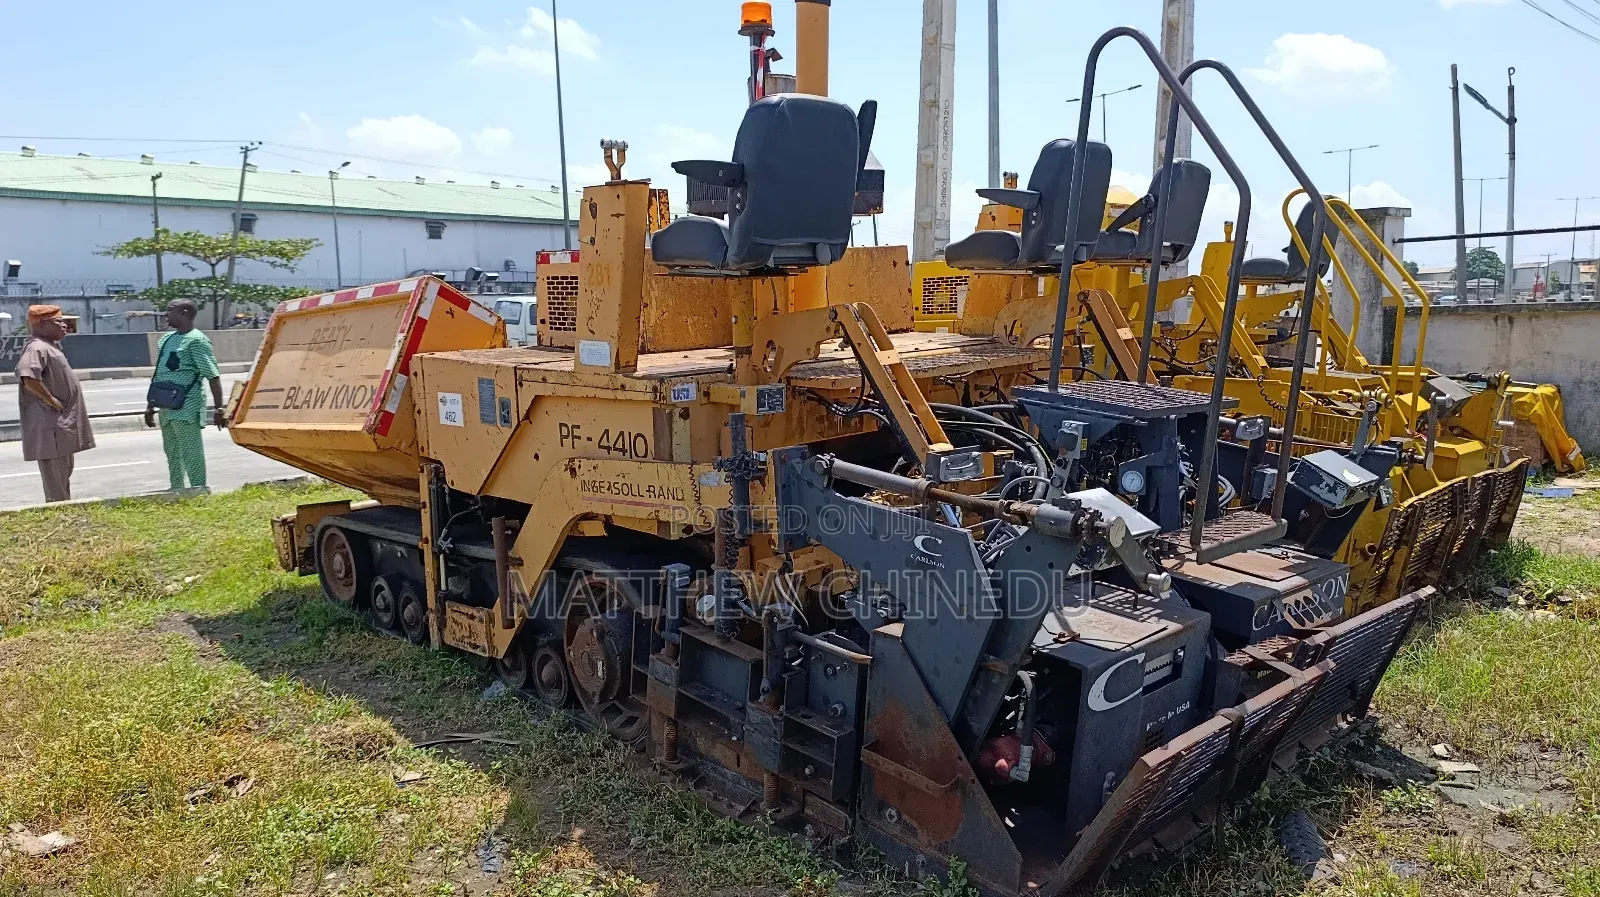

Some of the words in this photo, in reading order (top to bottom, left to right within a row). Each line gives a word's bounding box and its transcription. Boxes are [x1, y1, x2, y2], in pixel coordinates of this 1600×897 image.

[283, 385, 332, 410] BLAW
[329, 383, 378, 410] KNOX
[444, 411, 457, 423] 462
